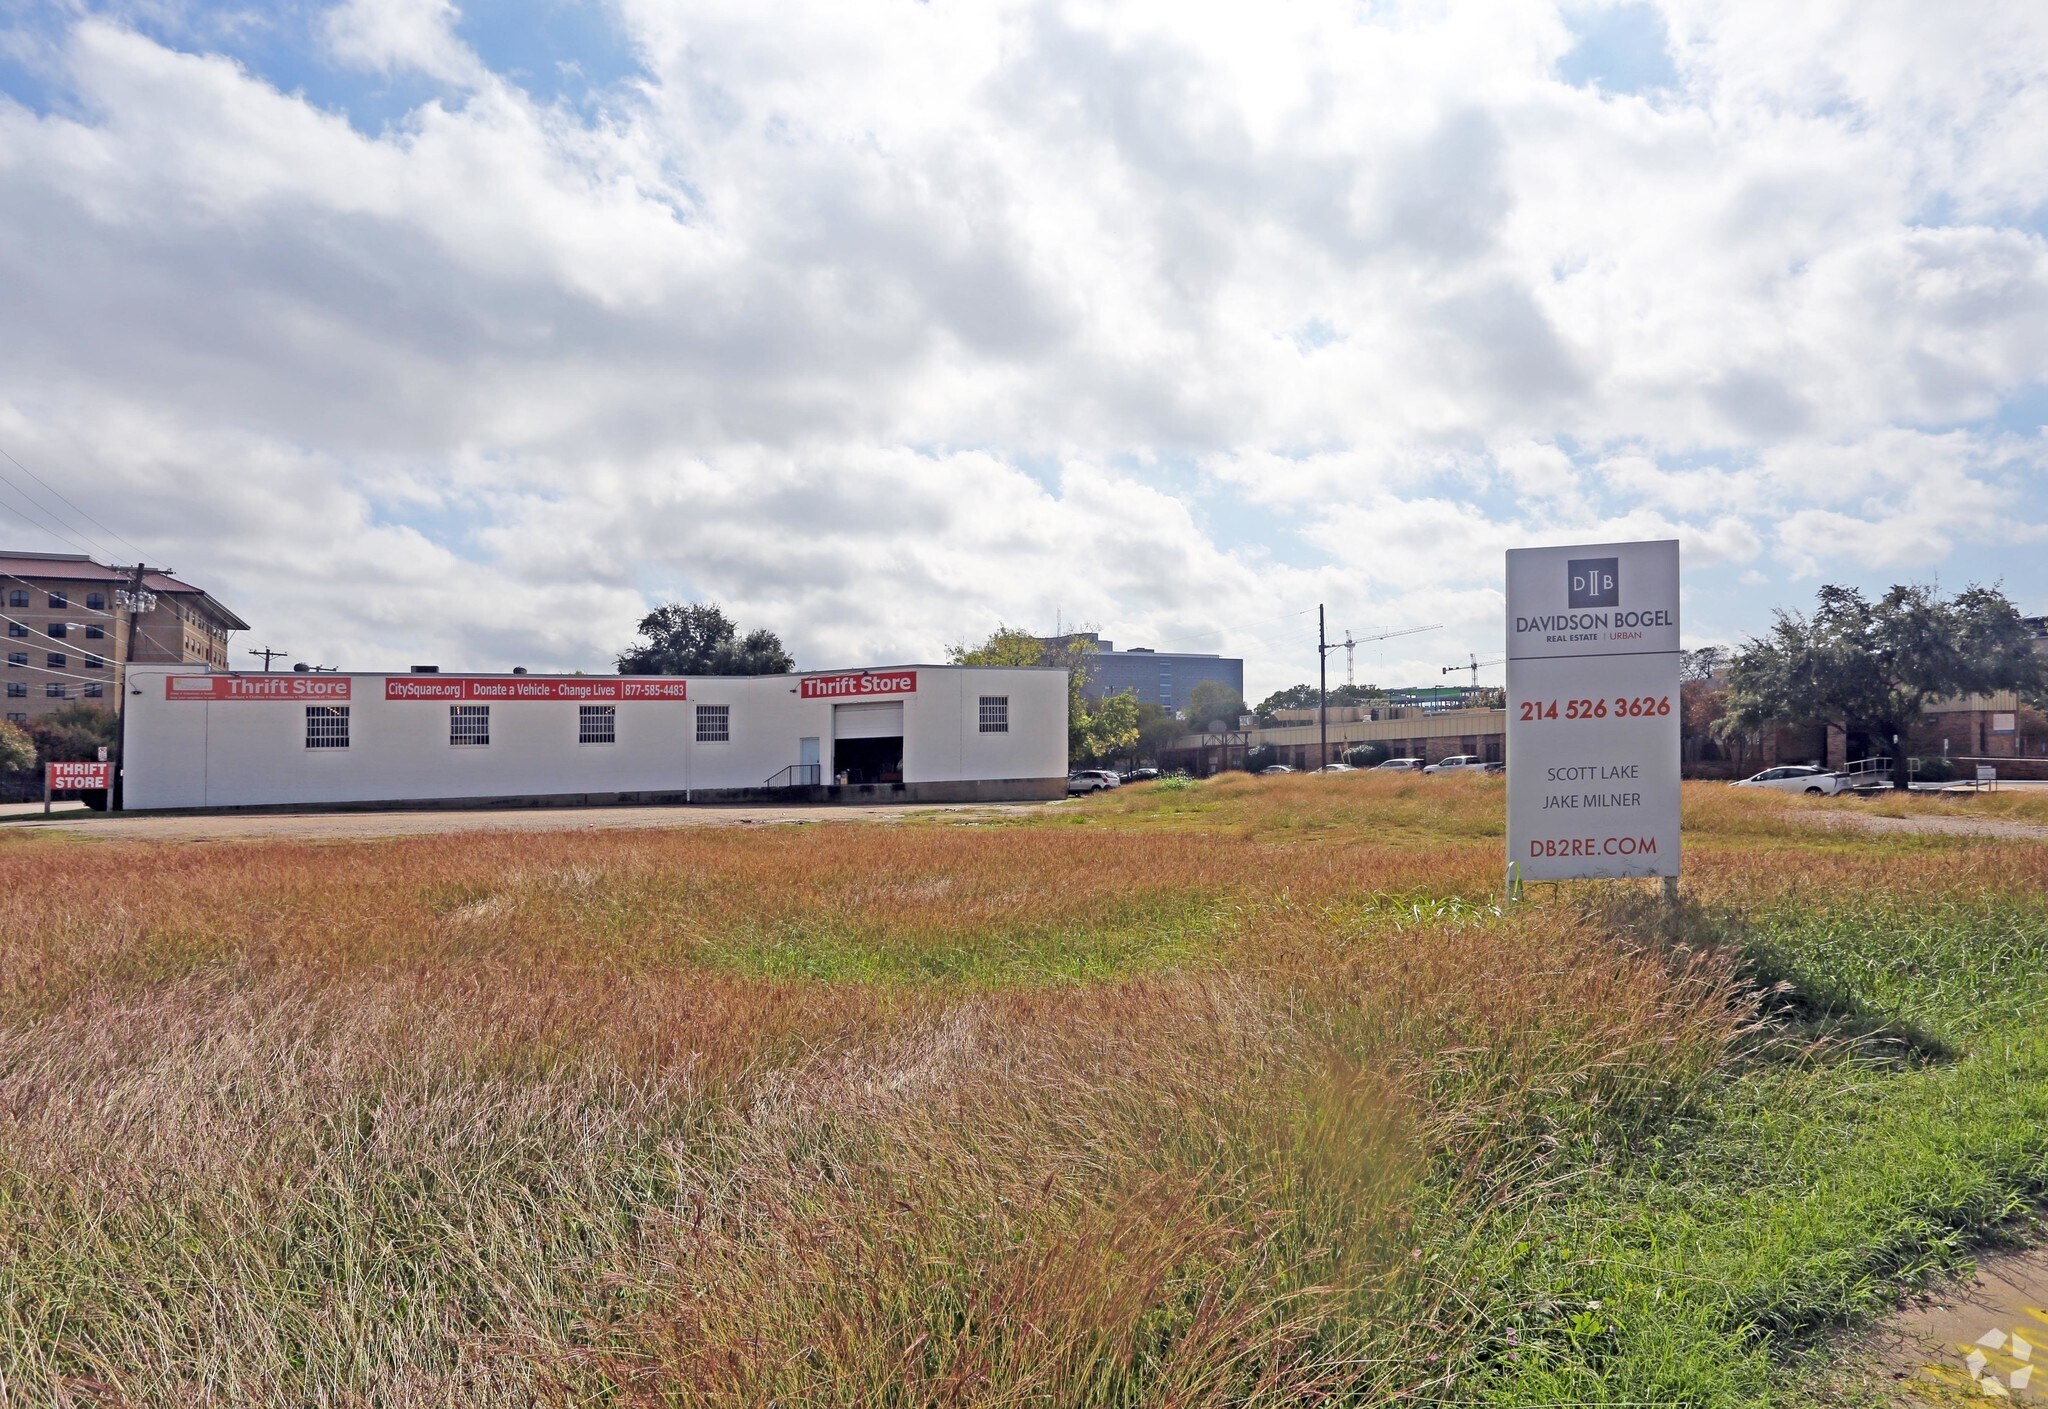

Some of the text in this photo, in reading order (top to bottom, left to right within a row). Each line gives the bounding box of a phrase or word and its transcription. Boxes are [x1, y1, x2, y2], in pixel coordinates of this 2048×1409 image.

[1516, 610, 1673, 633] DAVIDSON BOGEL
[1546, 631, 1642, 643] REAL ESTATE URBAN
[227, 679, 288, 694] Thrift
[292, 679, 347, 694] Store
[388, 682, 460, 698] CitySquare.org
[473, 683, 507, 696] Donate
[509, 687, 515, 696] a
[517, 683, 550, 696] Vehicle
[558, 684, 591, 698] Change
[593, 684, 615, 696] Lives
[625, 684, 684, 696] 877-585-4483
[804, 676, 911, 696] Thrift Store
[1519, 695, 1671, 721] 214 526 3626
[53, 763, 107, 775] THRIFT
[1547, 765, 1639, 781] SCOTT LAKE
[55, 776, 104, 789] STORE
[1542, 793, 1641, 809] JAKE MILNER
[1530, 836, 1657, 857] DB2RE.COM
